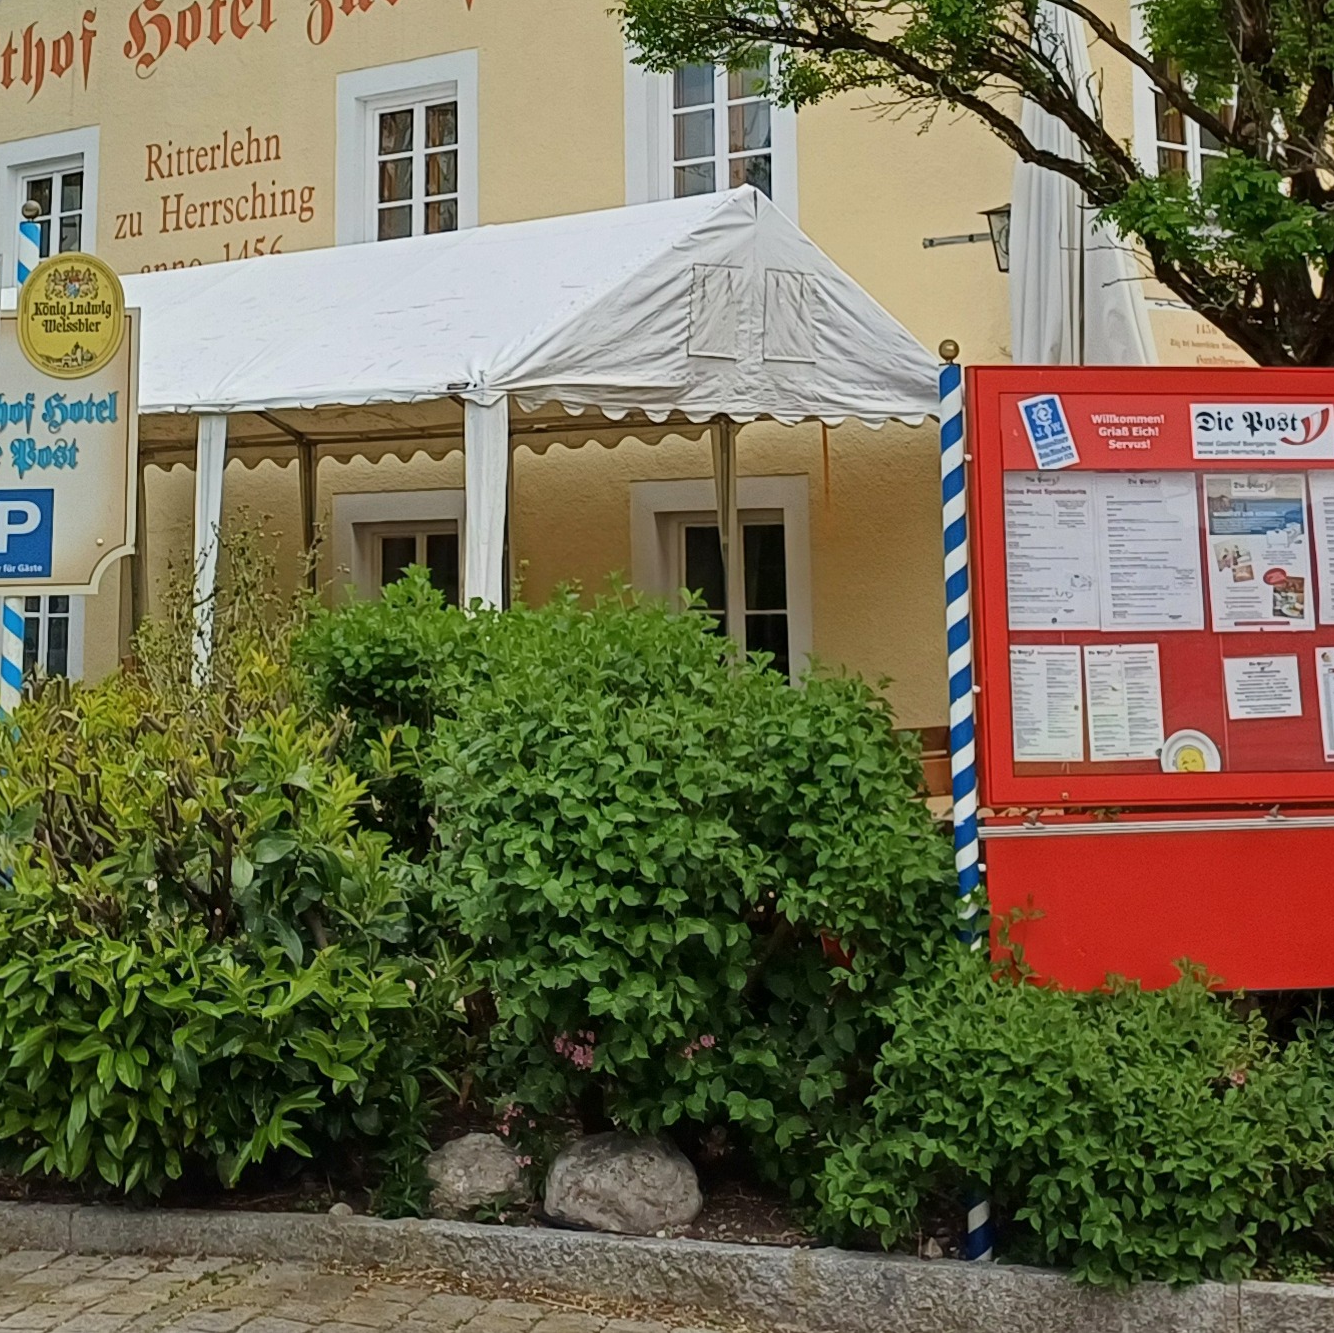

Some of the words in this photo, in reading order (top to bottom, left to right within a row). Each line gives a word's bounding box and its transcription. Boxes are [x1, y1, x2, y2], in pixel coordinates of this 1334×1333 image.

[144, 126, 281, 182] Ritterlehn
[114, 213, 142, 240] zu
[159, 181, 316, 234] Herrsching
[31, 301, 67, 321] König
[67, 301, 112, 320] Ludwig
[42, 318, 101, 332] Weissbier
[42, 390, 119, 433] Hotel
[1091, 414, 1165, 424] Willkommen!
[1098, 427, 1129, 437] Griaß
[1132, 427, 1159, 437] Eich!
[1195, 411, 1234, 431] Die
[1242, 411, 1298, 437] Post
[1108, 440, 1151, 449] Servus!
[10, 438, 80, 479] Post
[3, 563, 16, 573] für
[17, 563, 43, 573] Gäste
